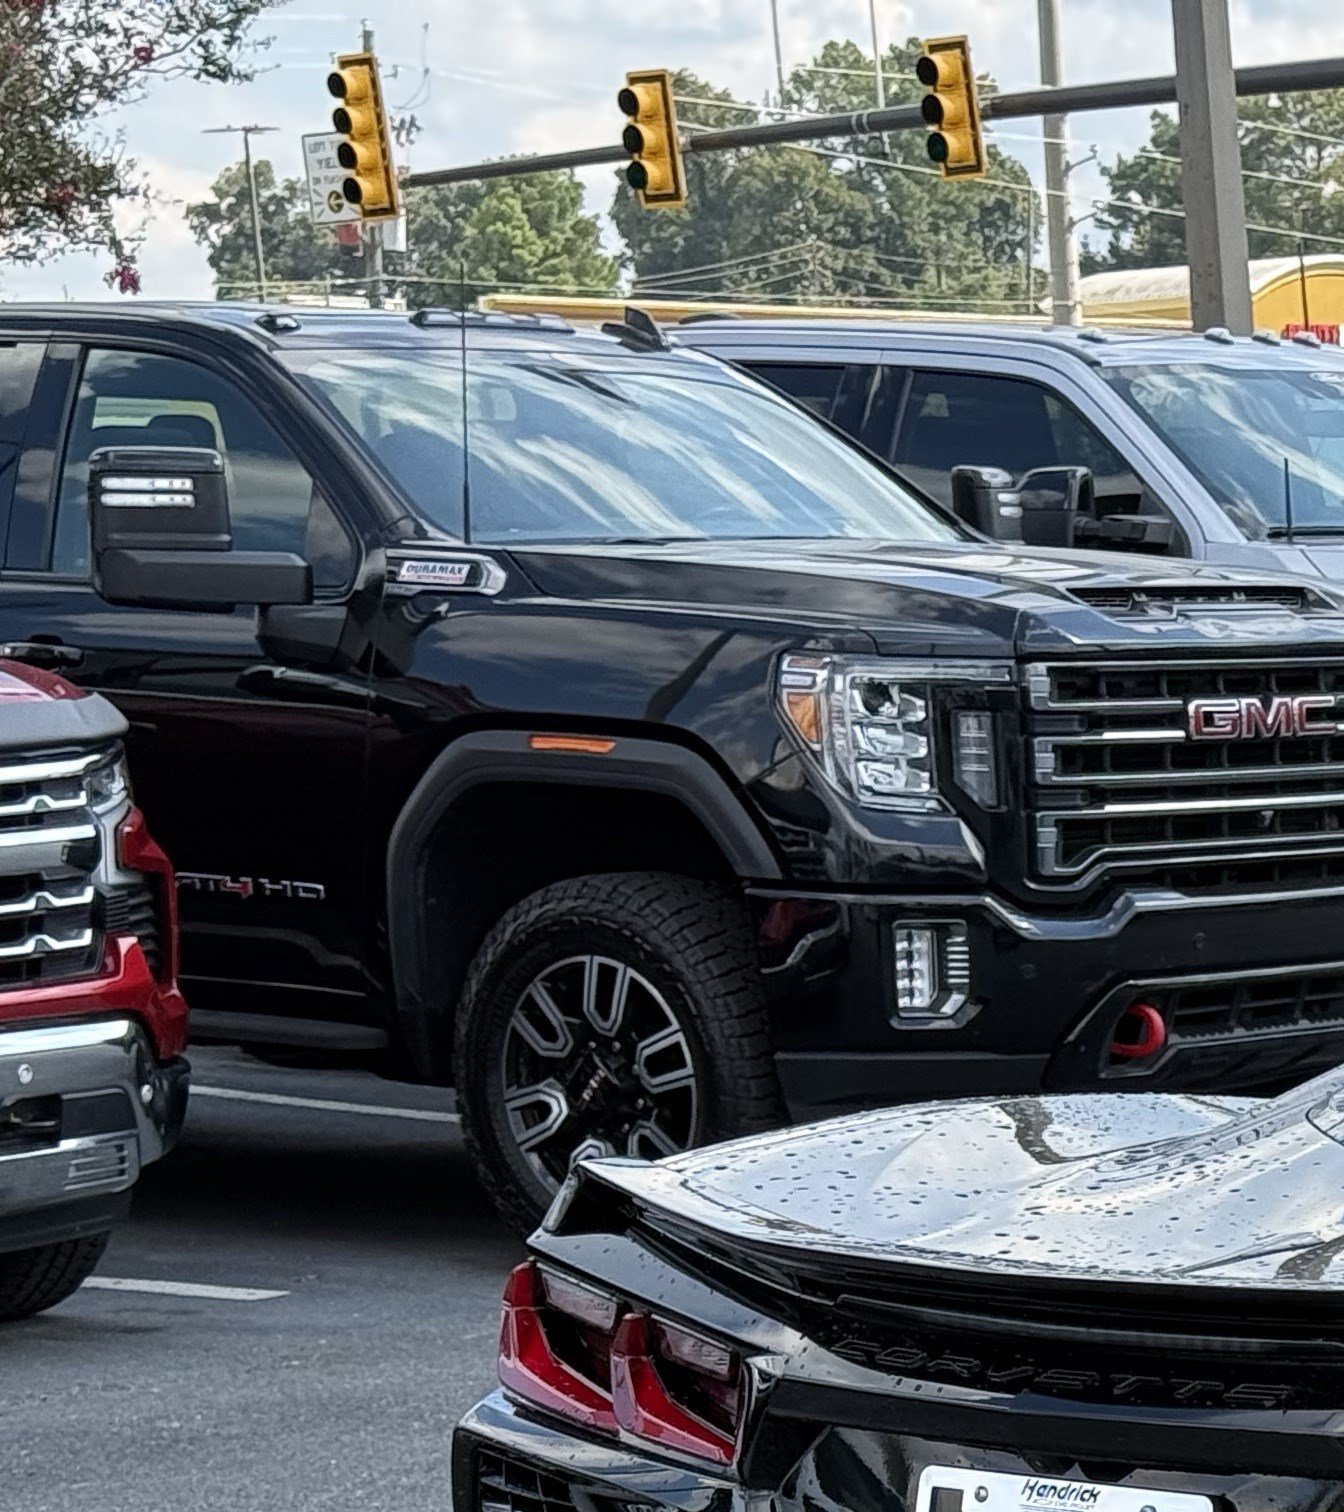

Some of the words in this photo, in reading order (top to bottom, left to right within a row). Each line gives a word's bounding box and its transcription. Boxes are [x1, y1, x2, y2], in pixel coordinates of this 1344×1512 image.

[1188, 696, 1335, 740] GMC
[258, 877, 326, 900] HD
[829, 1338, 1296, 1404] CORVETTE
[1020, 1479, 1101, 1503] Hendrick
